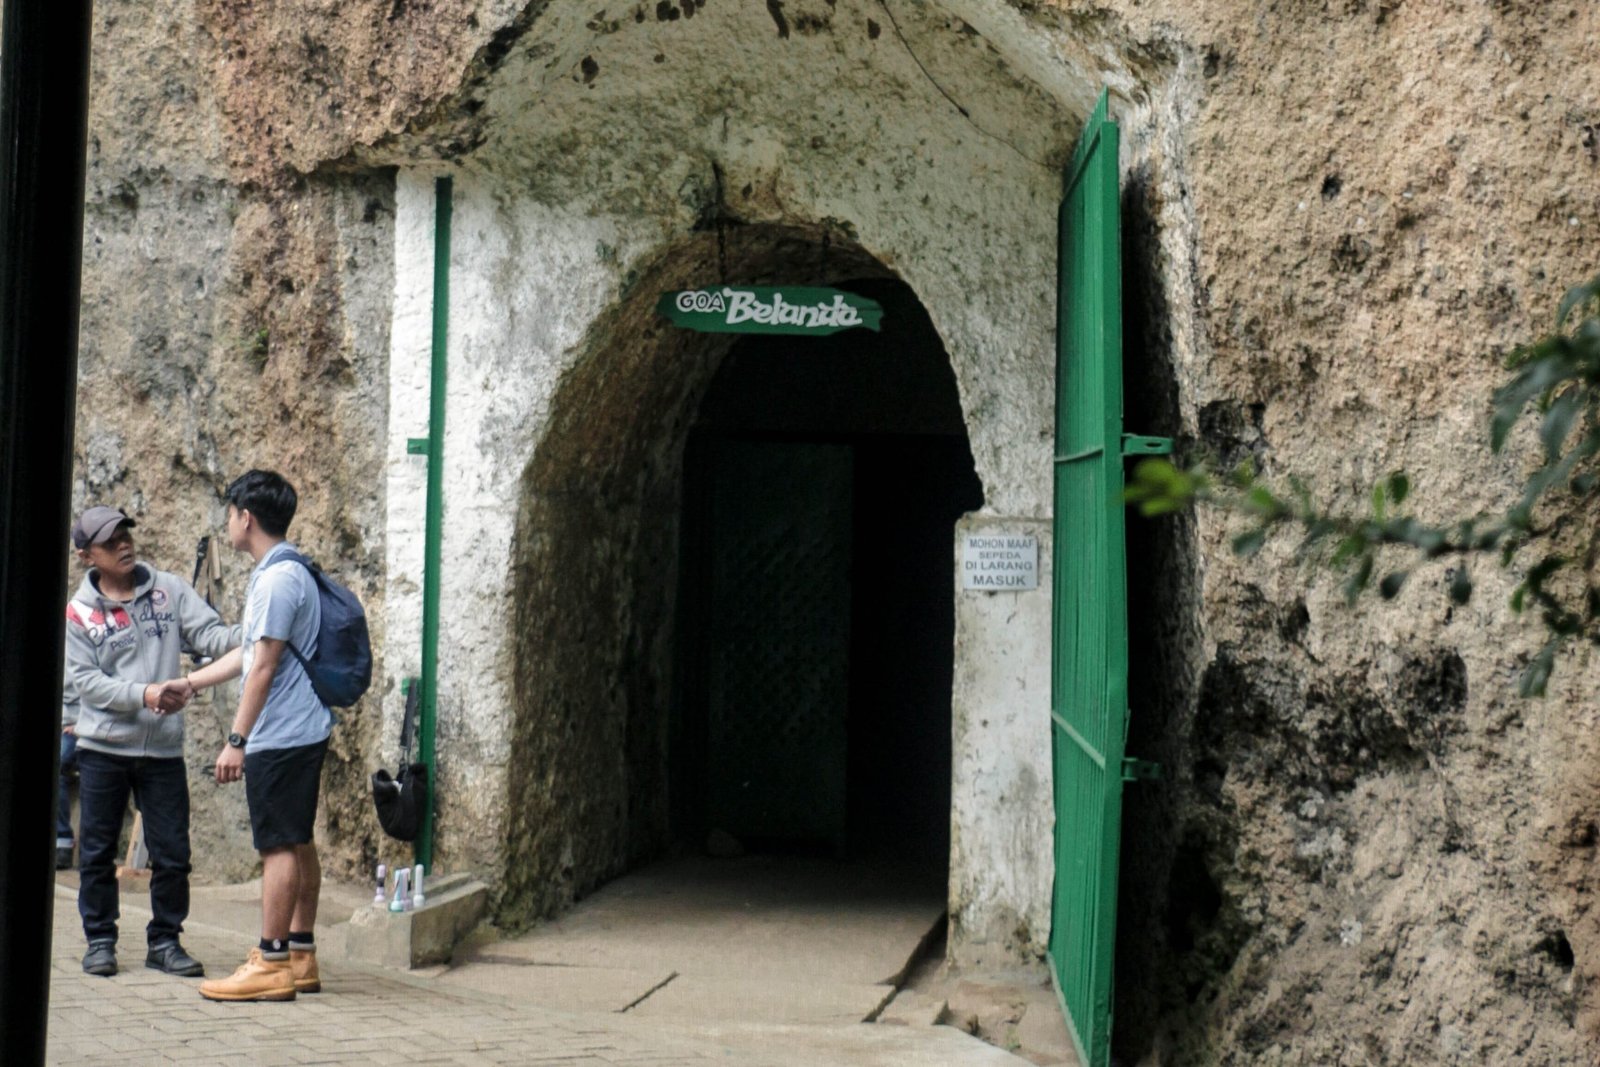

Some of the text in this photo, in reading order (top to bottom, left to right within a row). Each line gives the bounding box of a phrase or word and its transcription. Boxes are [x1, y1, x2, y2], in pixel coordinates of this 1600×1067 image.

[676, 287, 863, 328] GOA Belanda
[969, 538, 1033, 549] MOHON MAAF
[978, 551, 1022, 560] SEPEDA
[965, 560, 1033, 571] DI LARANG
[972, 575, 1027, 586] MASUK
